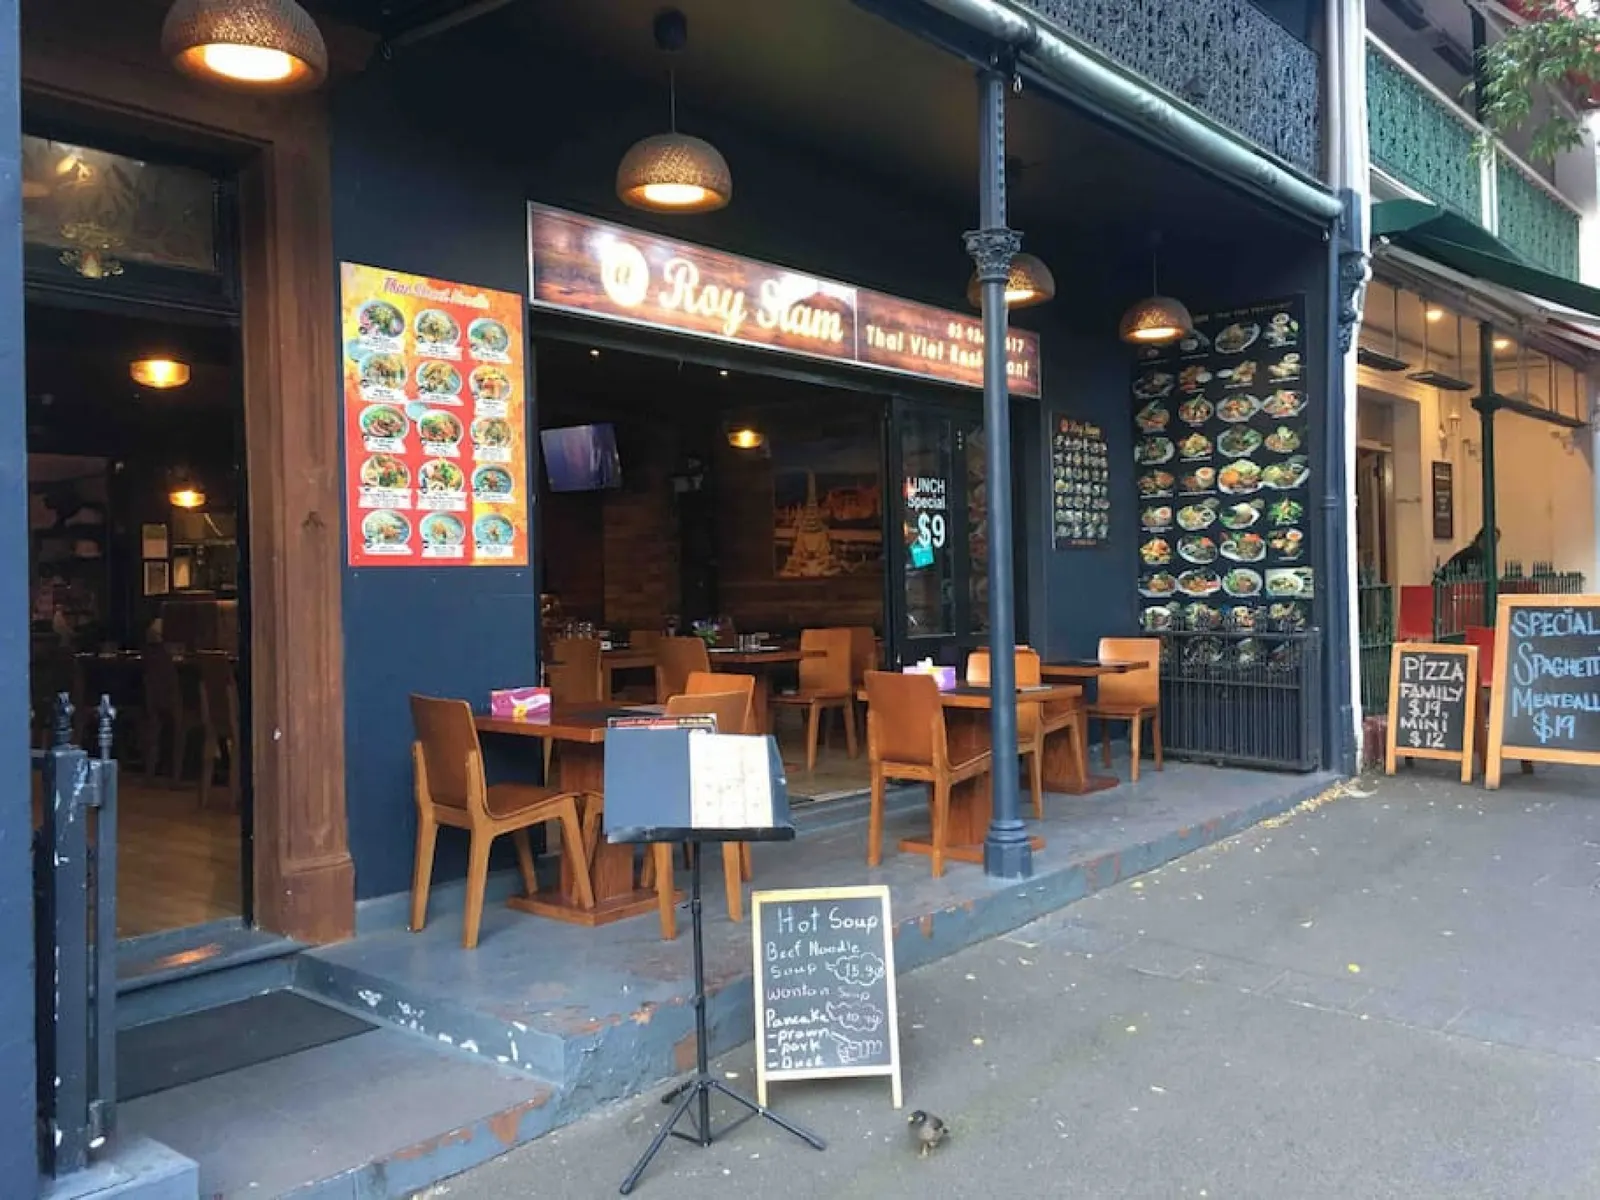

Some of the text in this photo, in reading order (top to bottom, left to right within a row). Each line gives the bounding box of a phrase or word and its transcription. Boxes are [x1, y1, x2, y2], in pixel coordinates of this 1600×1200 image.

[657, 257, 748, 337] Roy
[866, 324, 1030, 378] Thai Viet Restant
[907, 477, 946, 494] LUNCH
[917, 510, 946, 548] $9
[1404, 655, 1464, 682] PIZZA
[1513, 642, 1600, 686] SPAGHETT
[1400, 682, 1463, 702] FAMILY
[1409, 730, 1446, 748] $12
[1532, 709, 1575, 744] $19
[778, 906, 879, 936] Hot Soup
